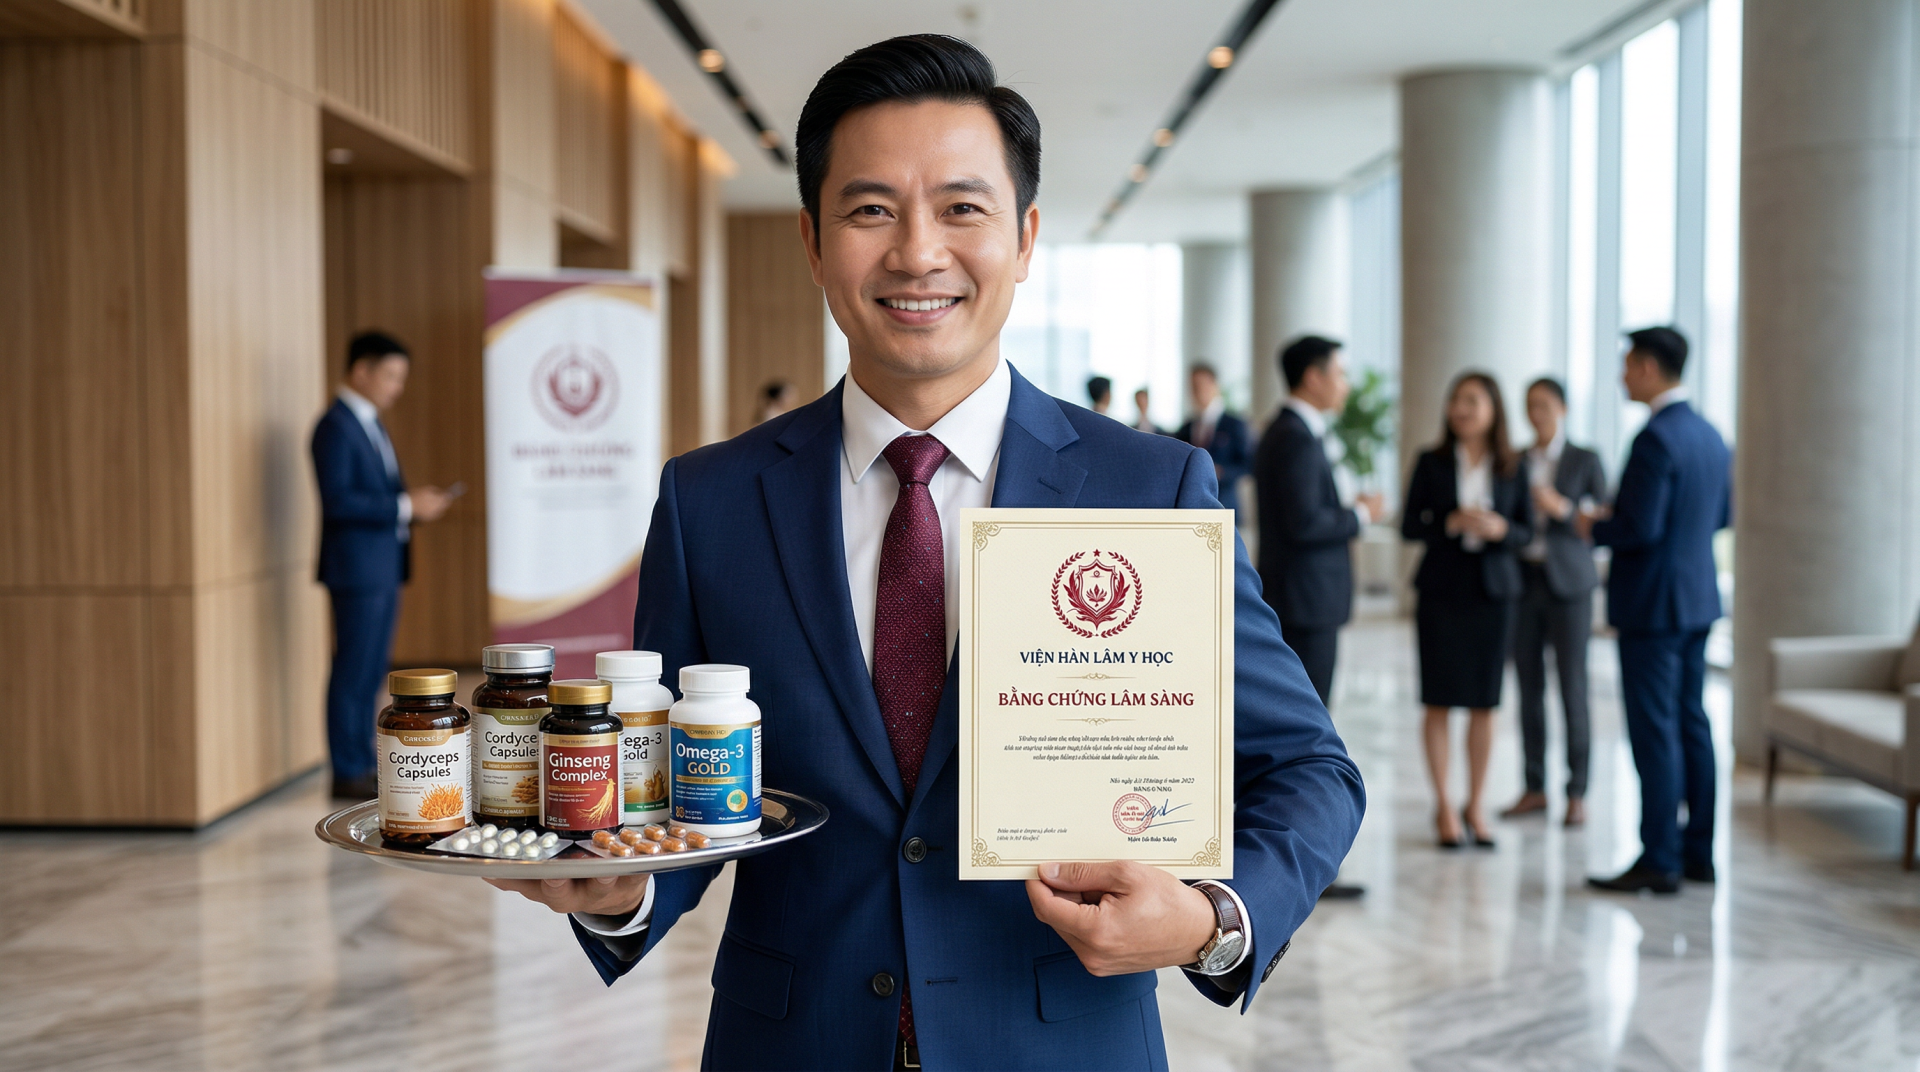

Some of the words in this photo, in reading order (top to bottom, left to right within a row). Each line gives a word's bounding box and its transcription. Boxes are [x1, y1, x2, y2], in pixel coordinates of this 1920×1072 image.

[1019, 648, 1055, 667] VIỆN
[1058, 647, 1090, 664] HÀN
[1093, 647, 1126, 664] LÂM
[1128, 651, 1139, 664] Y
[1141, 651, 1174, 667] HỌC
[998, 686, 1044, 707] BẰNG
[1047, 689, 1107, 707] CHỨNG
[1110, 689, 1146, 706] LÂM
[1150, 689, 1195, 707] SÀNG
[485, 731, 538, 747] Cordyce
[624, 732, 662, 750] ega-3
[389, 752, 459, 768] Cordyceps
[549, 752, 611, 770] Ginseng
[676, 743, 744, 763] Omega-3
[397, 767, 451, 781] Capsules
[687, 761, 731, 775] GOLD
[551, 769, 608, 785] Complex
